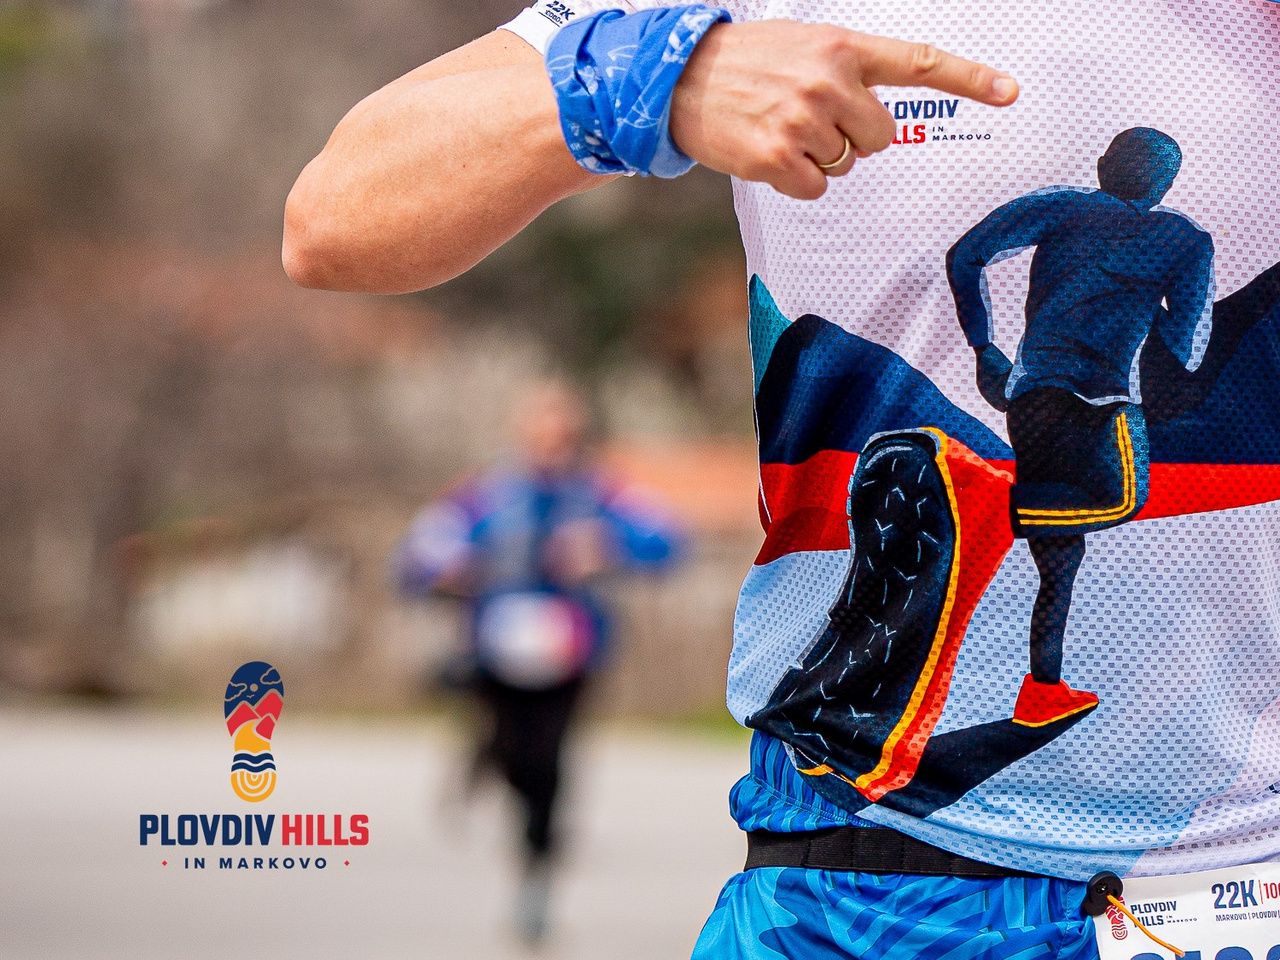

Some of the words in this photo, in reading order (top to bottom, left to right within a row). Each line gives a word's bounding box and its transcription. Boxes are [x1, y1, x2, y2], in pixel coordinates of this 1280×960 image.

[546, 0, 576, 21] 22K
[884, 99, 960, 120] OVDIV
[932, 133, 992, 142] MARKOVO
[1211, 879, 1259, 910] 22K
[1130, 901, 1178, 915] PLOVDIV
[1215, 912, 1247, 921] MARKOVO
[1251, 910, 1278, 919] PLOVDIV
